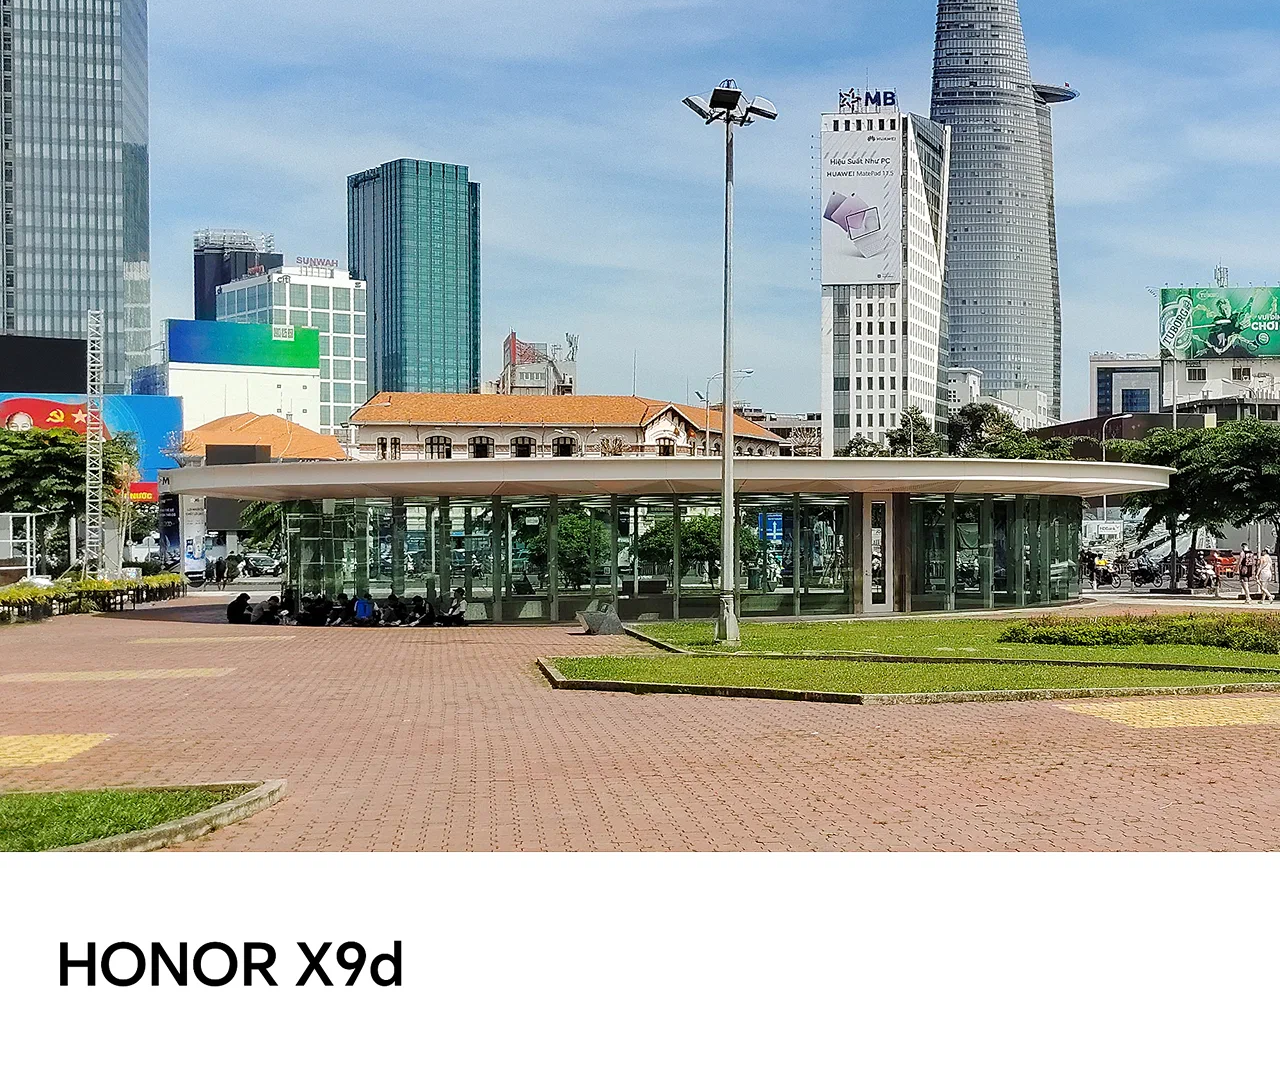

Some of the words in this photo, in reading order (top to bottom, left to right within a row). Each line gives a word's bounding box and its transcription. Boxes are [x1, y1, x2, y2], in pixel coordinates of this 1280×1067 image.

[864, 91, 896, 107] MB
[296, 256, 339, 267] SUNWAH
[1162, 305, 1189, 346] TUBORG
[1251, 320, 1279, 331] CHƠI
